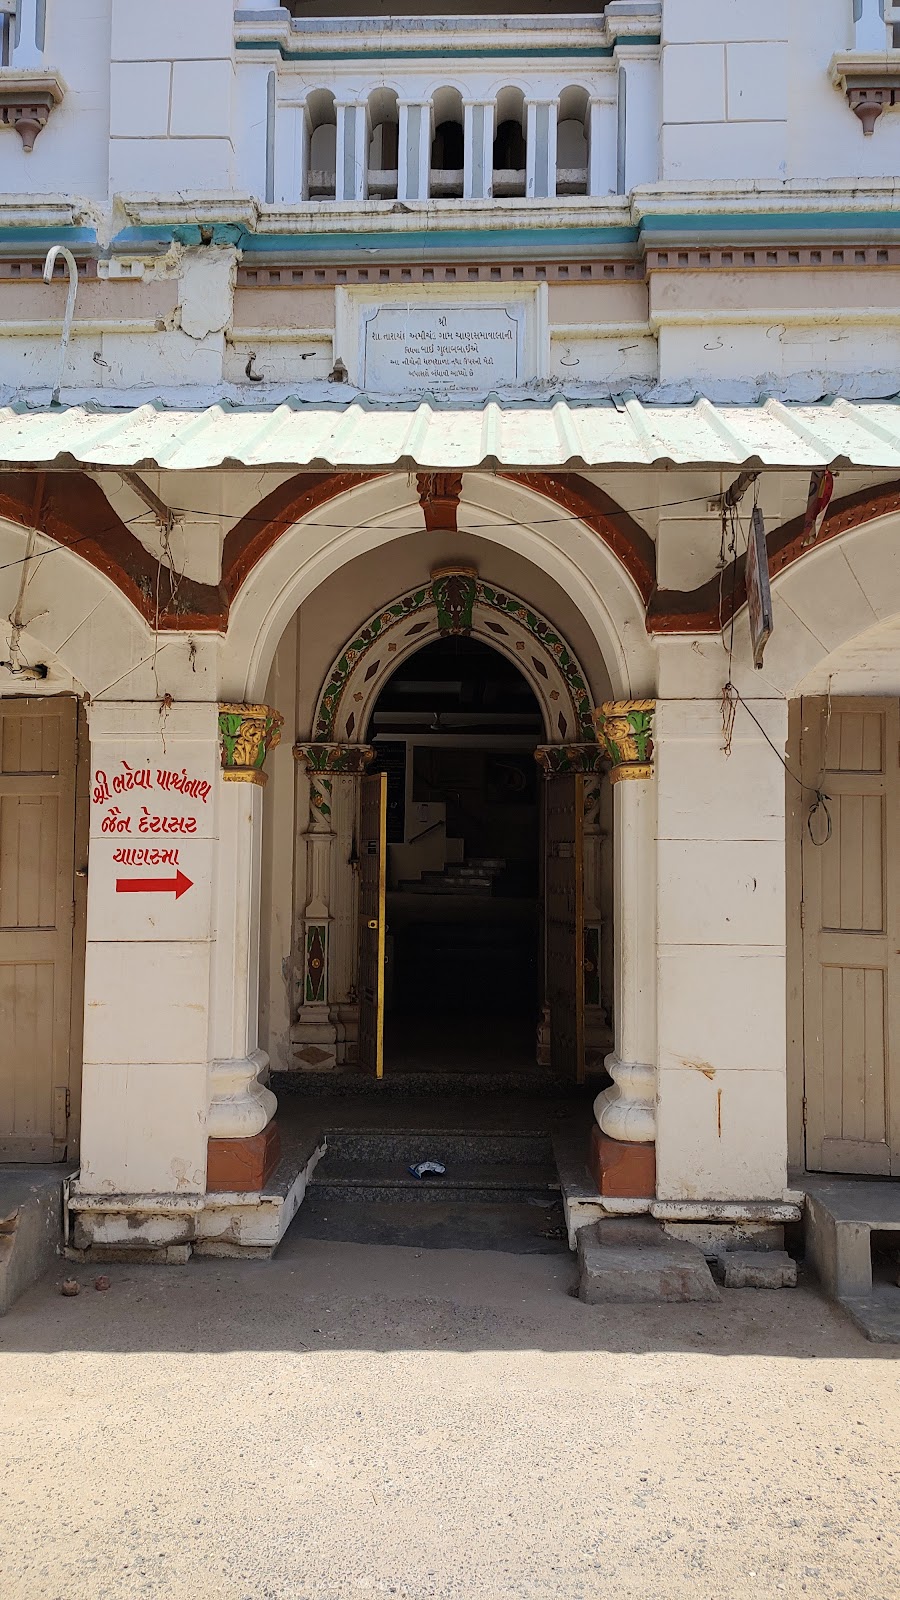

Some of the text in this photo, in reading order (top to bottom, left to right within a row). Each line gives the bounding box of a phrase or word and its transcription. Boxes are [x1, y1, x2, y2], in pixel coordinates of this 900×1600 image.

[438, 315, 448, 327] શ્રી
[438, 332, 454, 340] ગામ
[93, 770, 113, 804] શ્રી
[112, 760, 153, 794] ભટેવા
[101, 806, 198, 833] જૈન દેરાસર
